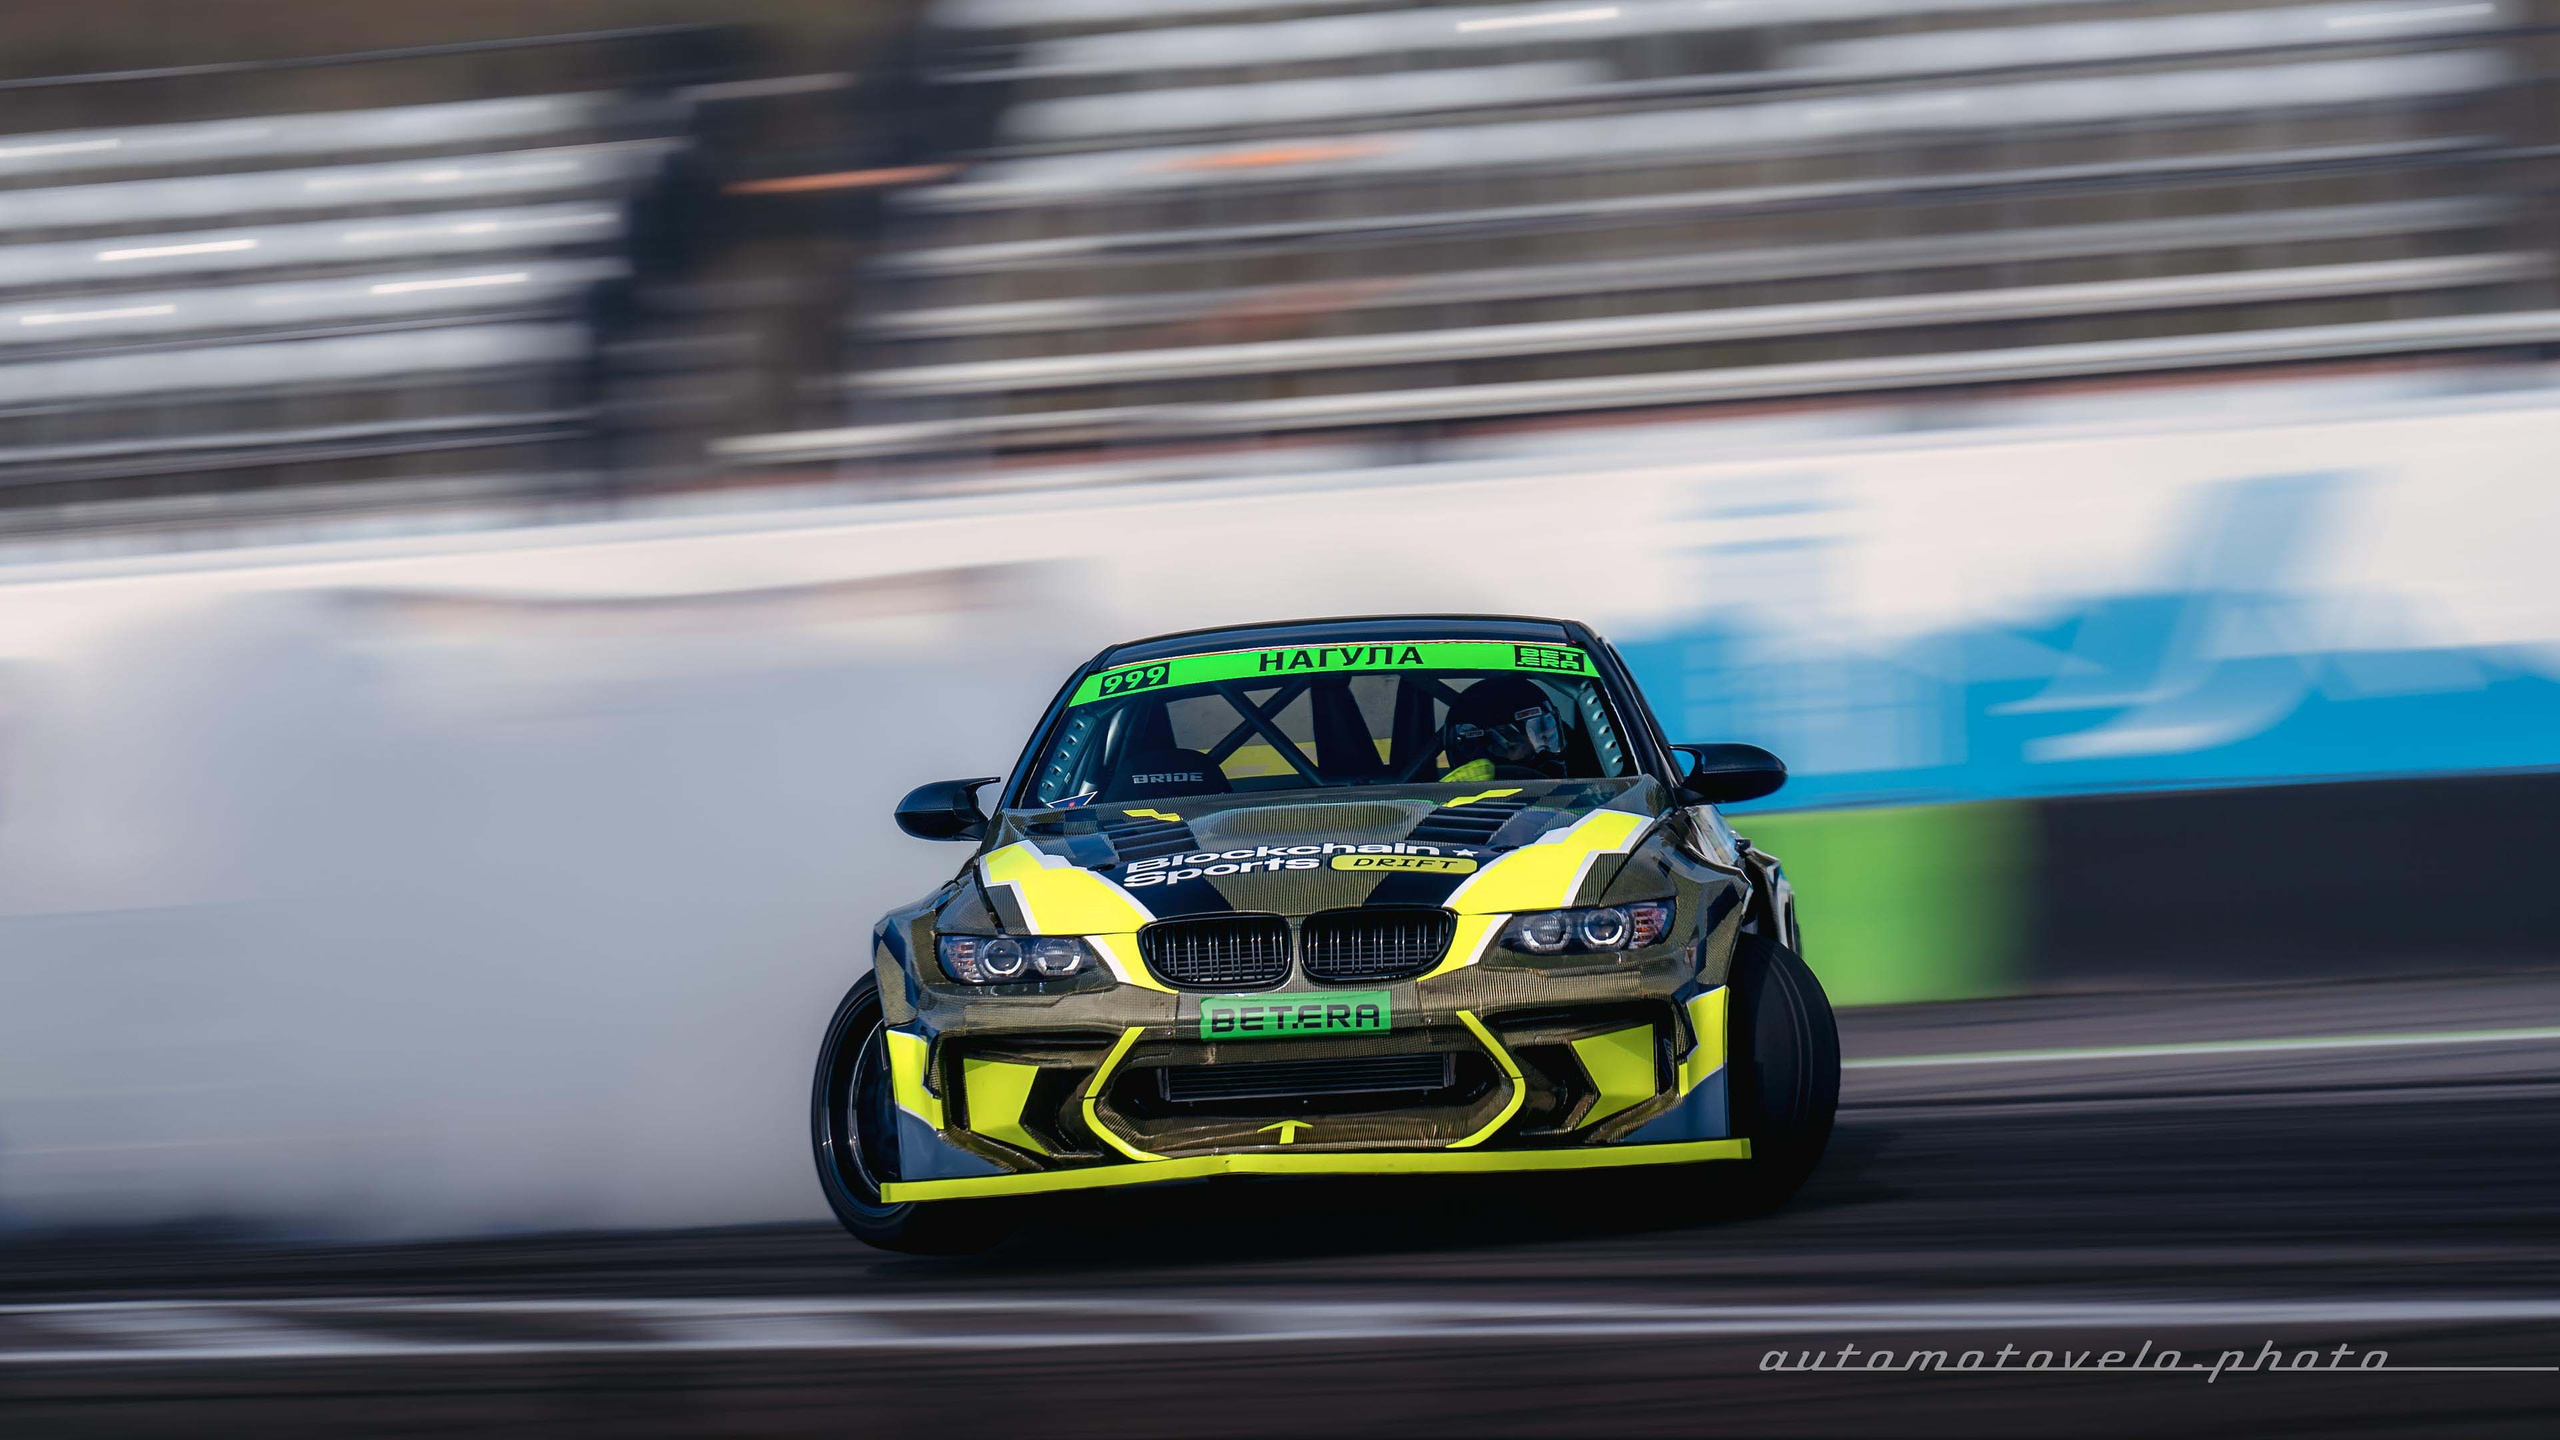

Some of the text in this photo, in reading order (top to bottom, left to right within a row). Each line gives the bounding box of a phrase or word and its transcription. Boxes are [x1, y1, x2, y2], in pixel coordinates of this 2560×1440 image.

[1259, 646, 1424, 672] НАГУЛА
[1520, 647, 1579, 661] BET
[1104, 666, 1166, 694] 999
[1131, 772, 1204, 784] BRIDE
[1126, 842, 1441, 874] Blockchain
[1123, 856, 1459, 888] Sports DRIFT
